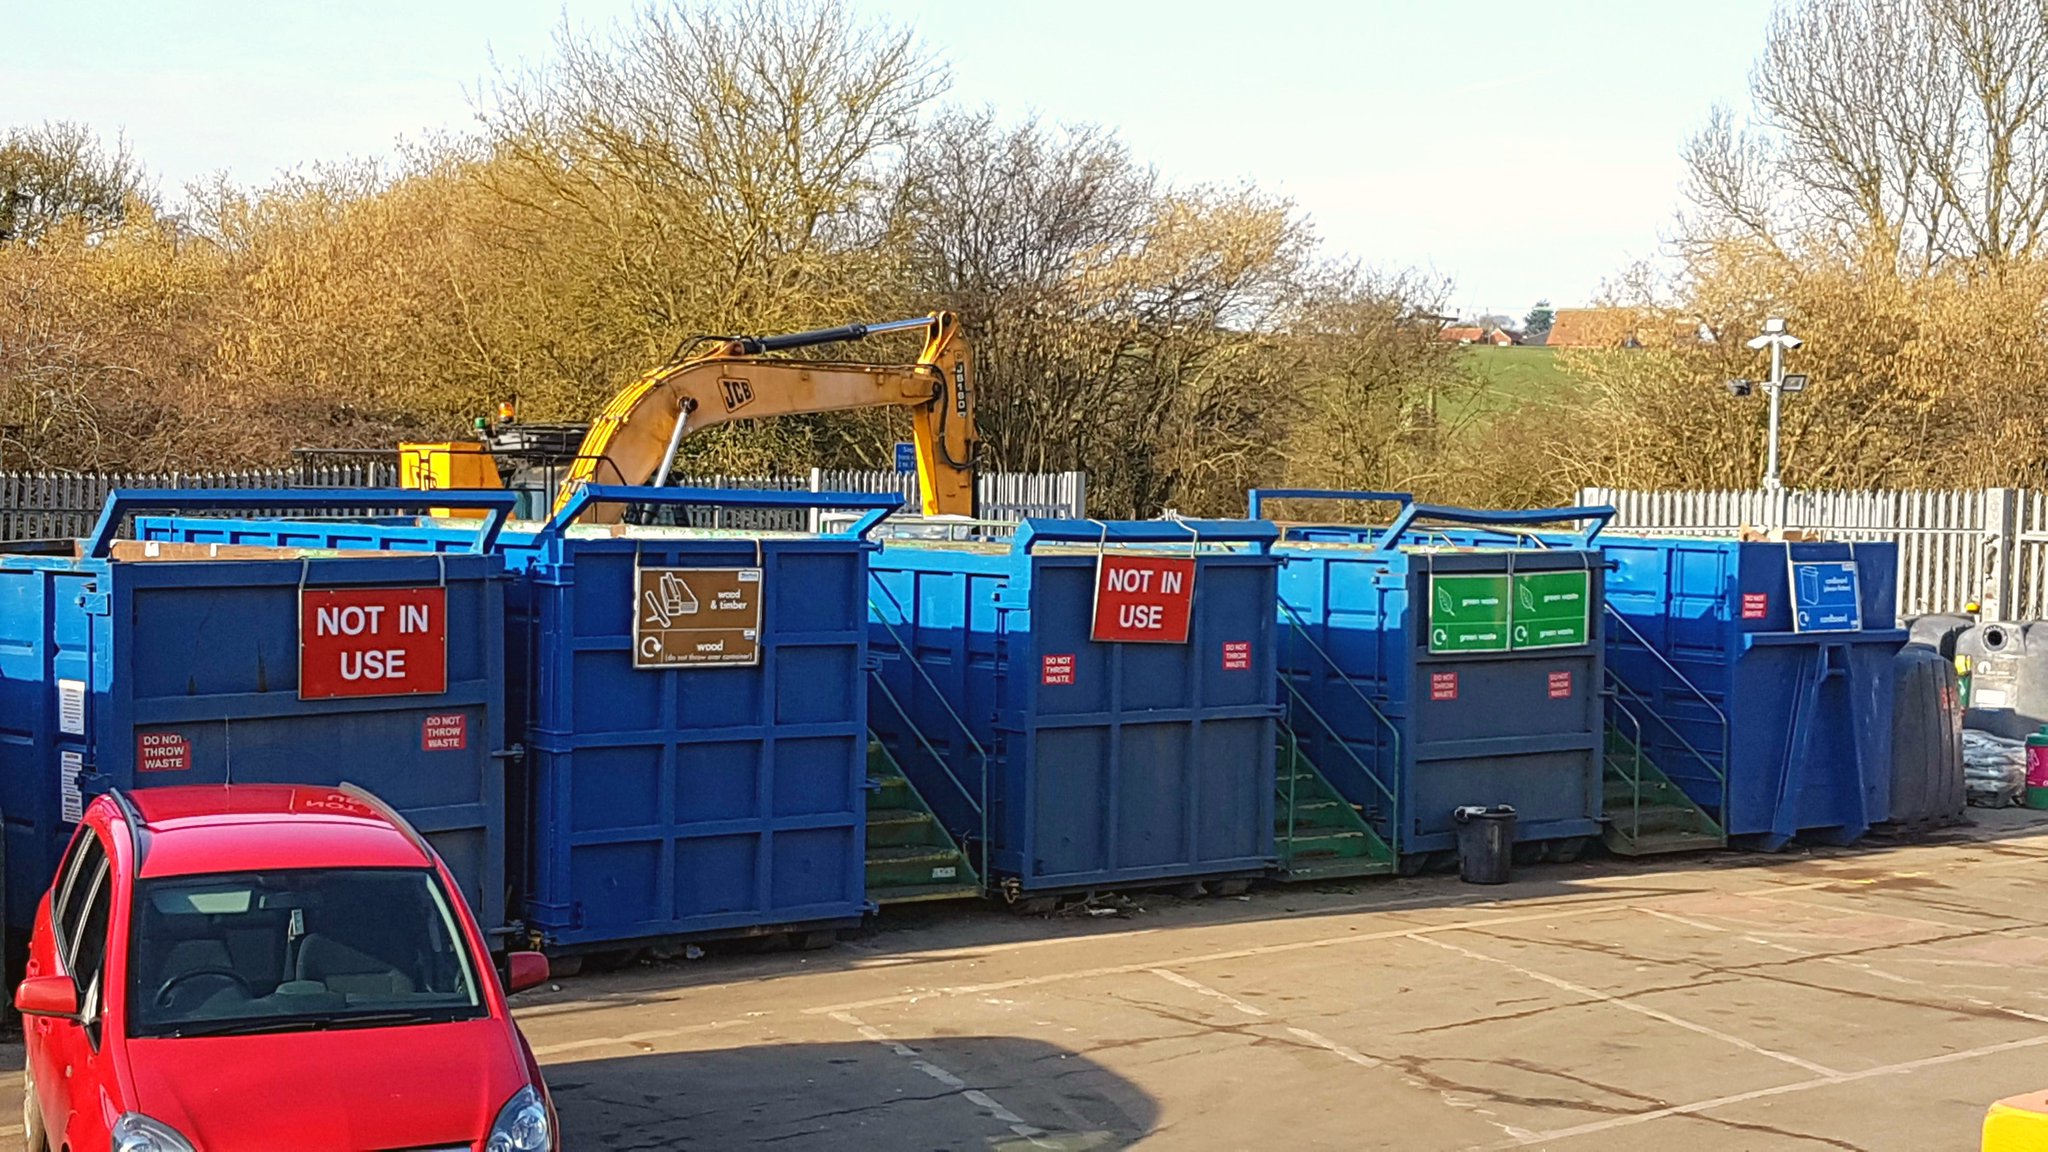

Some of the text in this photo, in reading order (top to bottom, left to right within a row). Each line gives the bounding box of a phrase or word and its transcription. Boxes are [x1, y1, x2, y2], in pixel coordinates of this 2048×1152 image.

[723, 381, 752, 409] JCB
[1107, 568, 1183, 594] NOT IN
[718, 589, 741, 599] wood
[1543, 593, 1579, 603] green waste
[710, 600, 748, 610] & timber
[1462, 599, 1480, 607] green
[317, 604, 428, 636] NOT IN
[1119, 604, 1164, 629] USE
[1459, 633, 1497, 642] green waste
[1540, 630, 1557, 639] green
[696, 639, 724, 651] wood
[1226, 643, 1247, 651] DO NOT
[340, 650, 405, 681] USE
[1045, 656, 1071, 665] DO NOT
[1046, 665, 1071, 674] THROW
[1046, 674, 1070, 683] WASTE
[426, 715, 461, 726] DO NOT
[427, 727, 462, 738] THROW
[143, 735, 160, 746] DO
[428, 738, 460, 748] WASTE
[143, 746, 185, 757] THROW
[144, 757, 183, 769] WASTE
